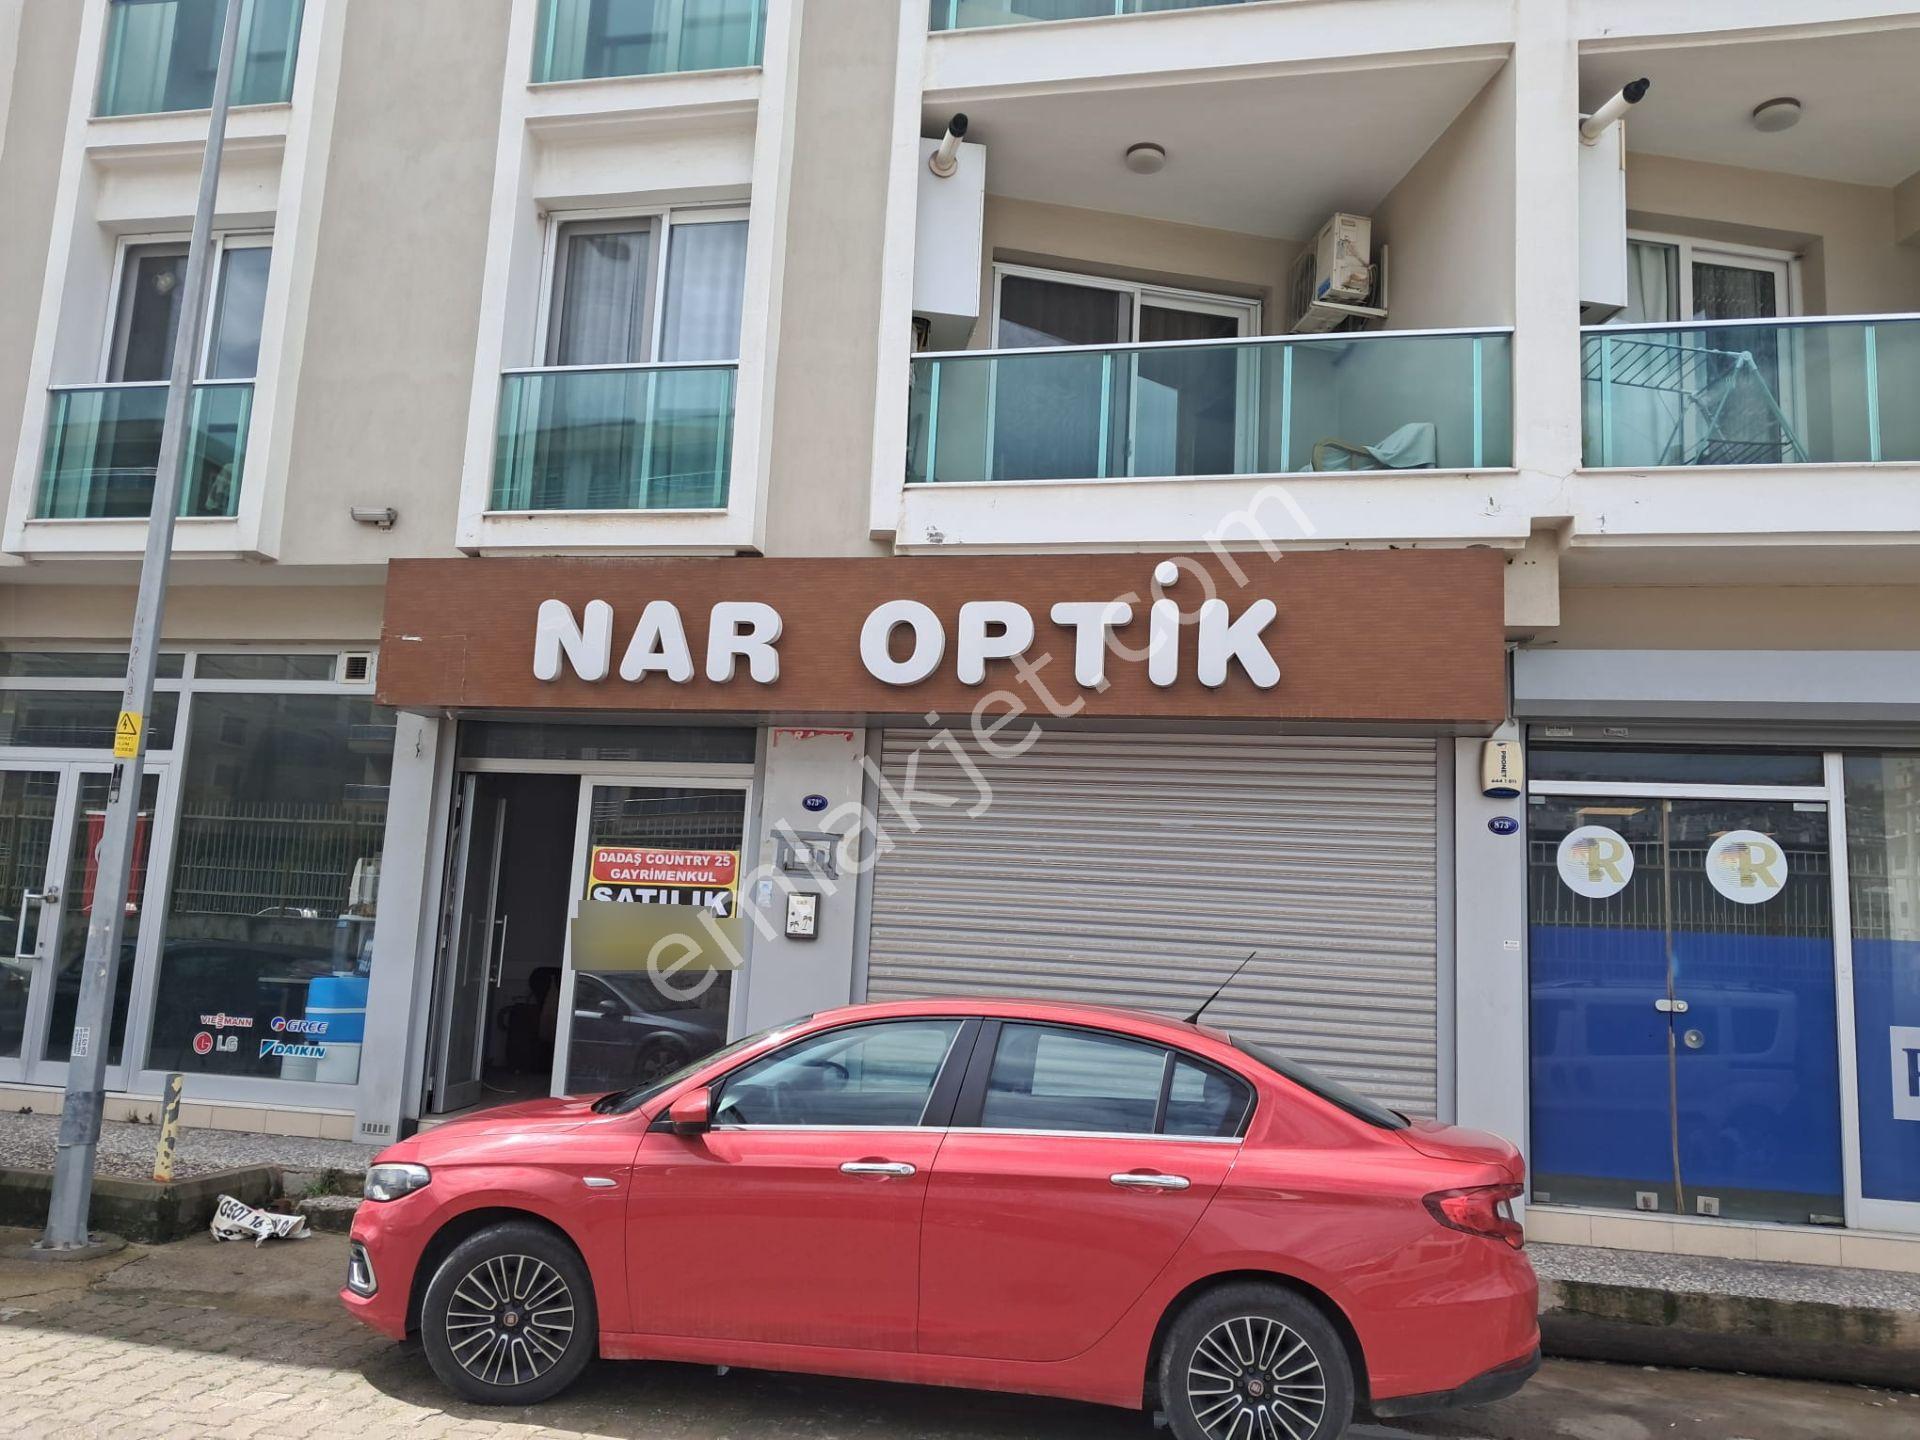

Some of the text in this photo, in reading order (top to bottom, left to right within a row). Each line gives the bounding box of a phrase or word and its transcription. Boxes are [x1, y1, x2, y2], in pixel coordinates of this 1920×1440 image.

[532, 560, 1282, 690] NAR OPTİK
[599, 852, 731, 867] DADAŞ COUNTRY 25
[610, 866, 717, 883] GAYRİMENKUL
[200, 1013, 253, 1029] VIESSMANN
[286, 1020, 329, 1034] GREE
[215, 1035, 239, 1052] LG
[272, 1044, 327, 1058] DAIKIN
